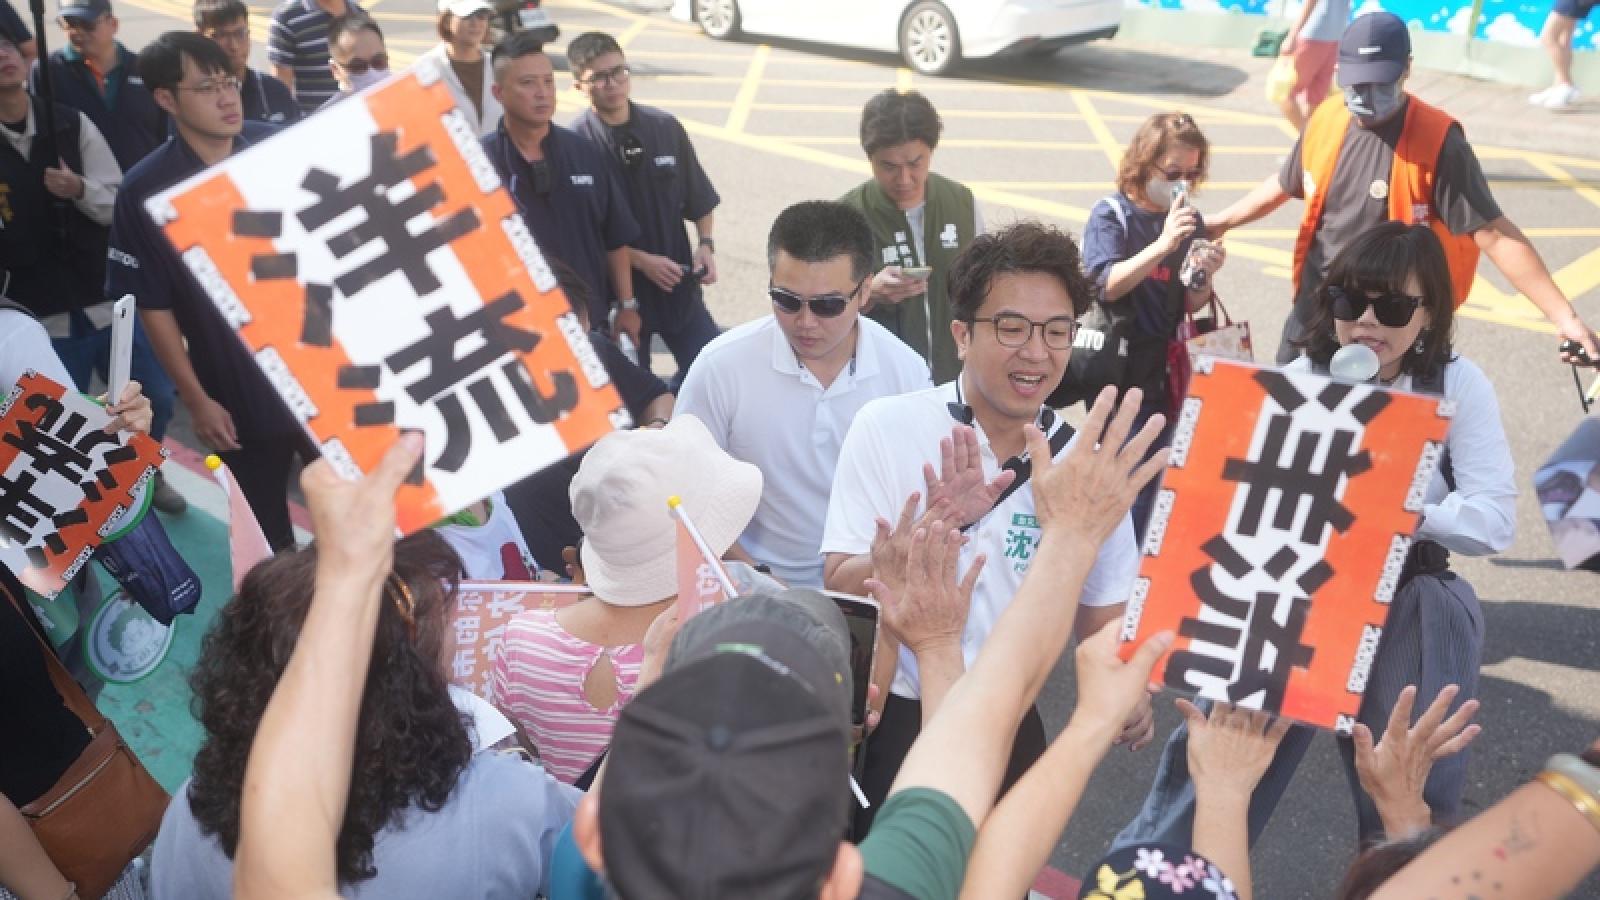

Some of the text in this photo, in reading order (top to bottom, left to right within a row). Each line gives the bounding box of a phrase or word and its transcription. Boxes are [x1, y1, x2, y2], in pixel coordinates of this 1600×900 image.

[231, 131, 580, 486] 洋流
[0, 394, 138, 568] 洋流
[1004, 529, 1043, 559] 沈
[1163, 369, 1393, 712] 洋流
